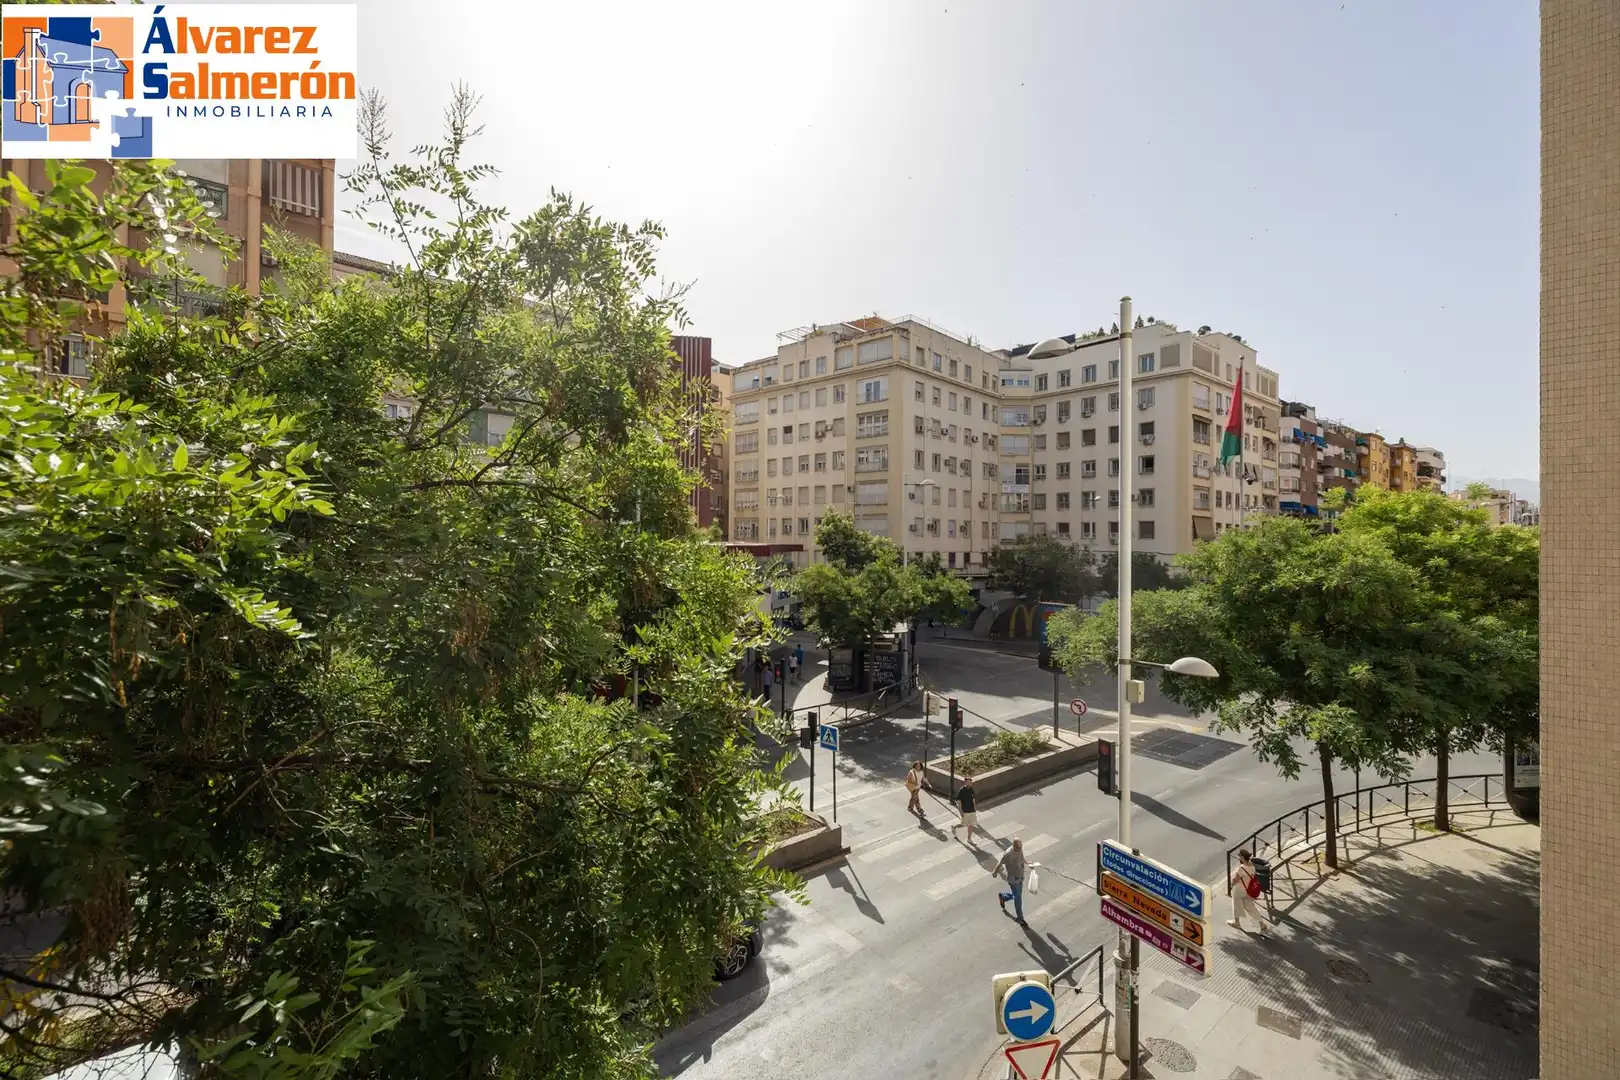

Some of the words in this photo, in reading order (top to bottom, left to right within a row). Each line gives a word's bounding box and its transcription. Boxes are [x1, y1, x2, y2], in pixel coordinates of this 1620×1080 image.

[1103, 846, 1169, 886] Circunvalación
[1102, 905, 1144, 935] Alhambra
[1103, 879, 1128, 899] Sierra
[1132, 896, 1167, 921] Nevada
